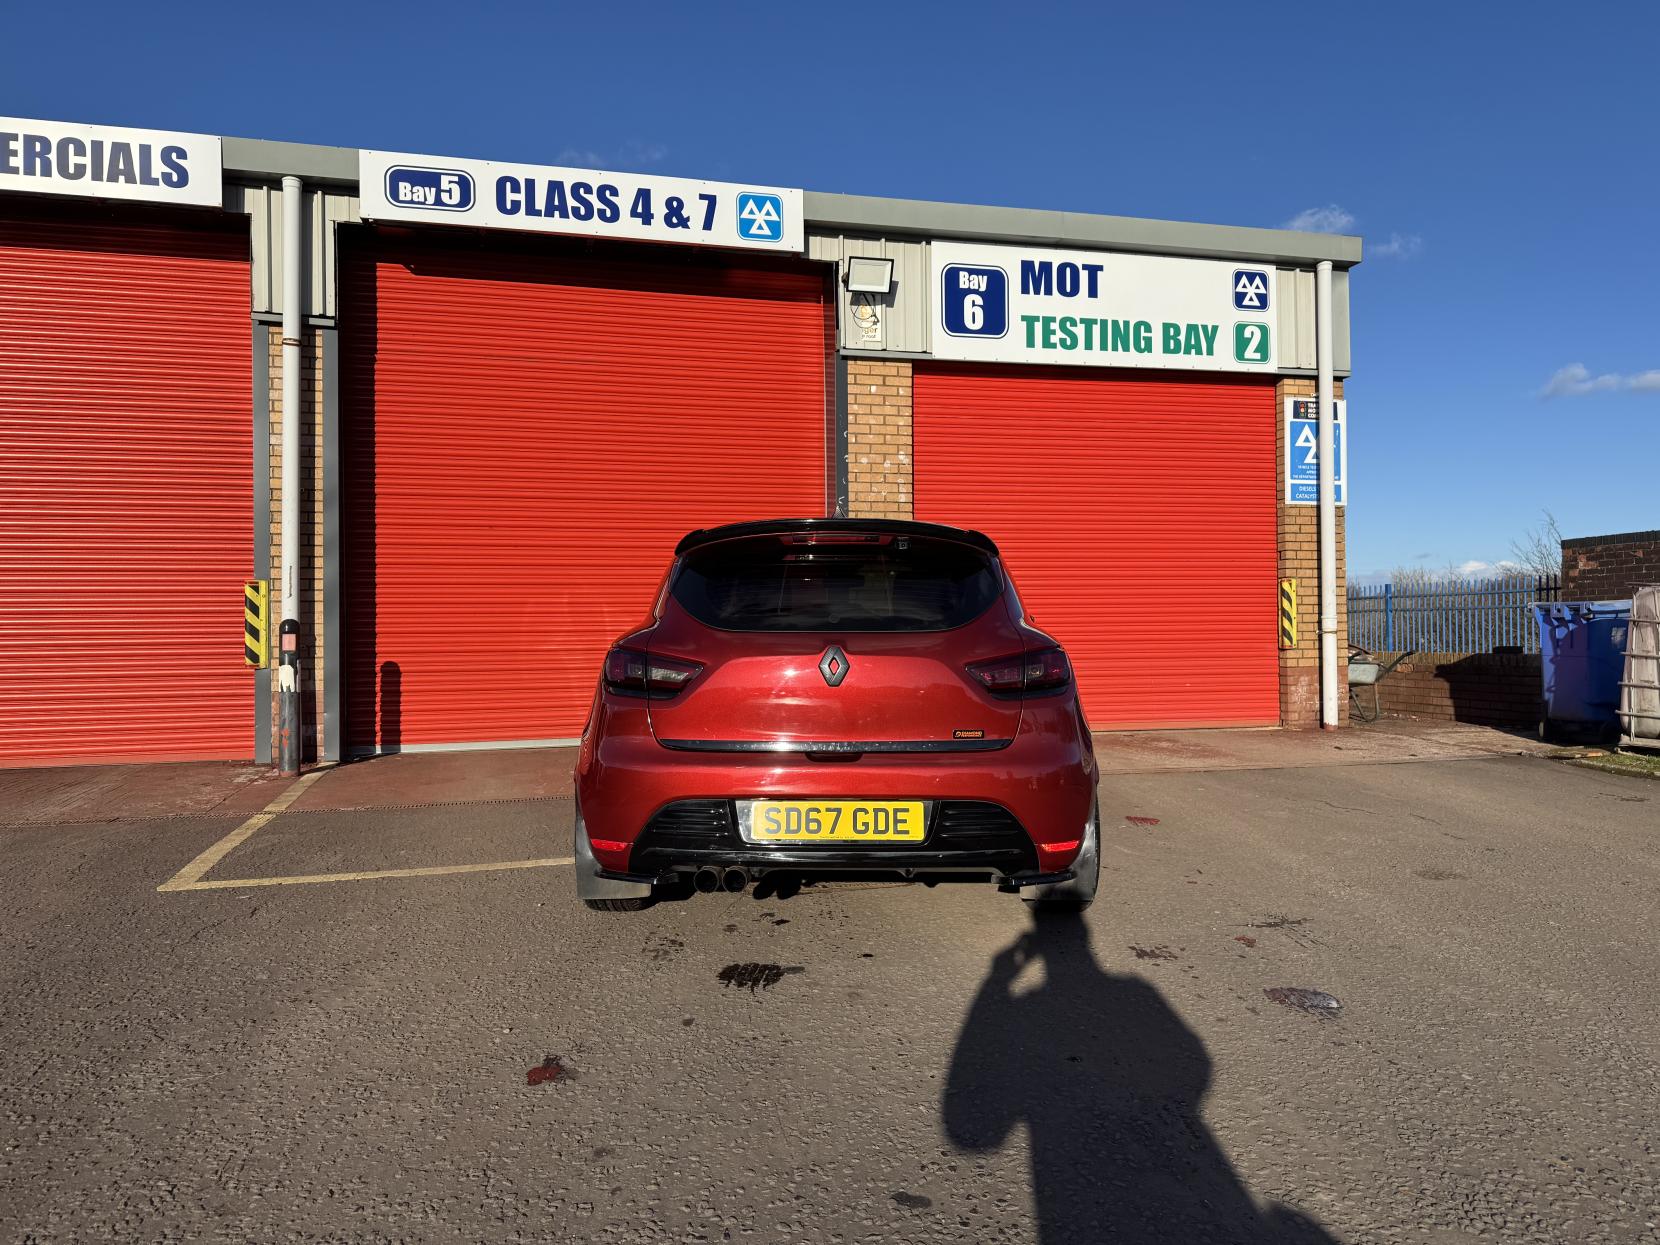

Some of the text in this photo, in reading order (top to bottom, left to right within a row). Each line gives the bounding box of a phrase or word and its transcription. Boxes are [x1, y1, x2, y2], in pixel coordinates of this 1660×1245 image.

[0, 131, 190, 189] ERCIALS
[398, 174, 461, 205] Bay 5
[495, 175, 717, 232] CLASS 4 & 7
[959, 270, 988, 292] Bay
[1020, 259, 1104, 299] MOT
[963, 293, 984, 331] 6
[1020, 314, 1220, 357] TESTING BAY
[1243, 325, 1262, 360] 2
[764, 807, 910, 835] SD67 GDE
